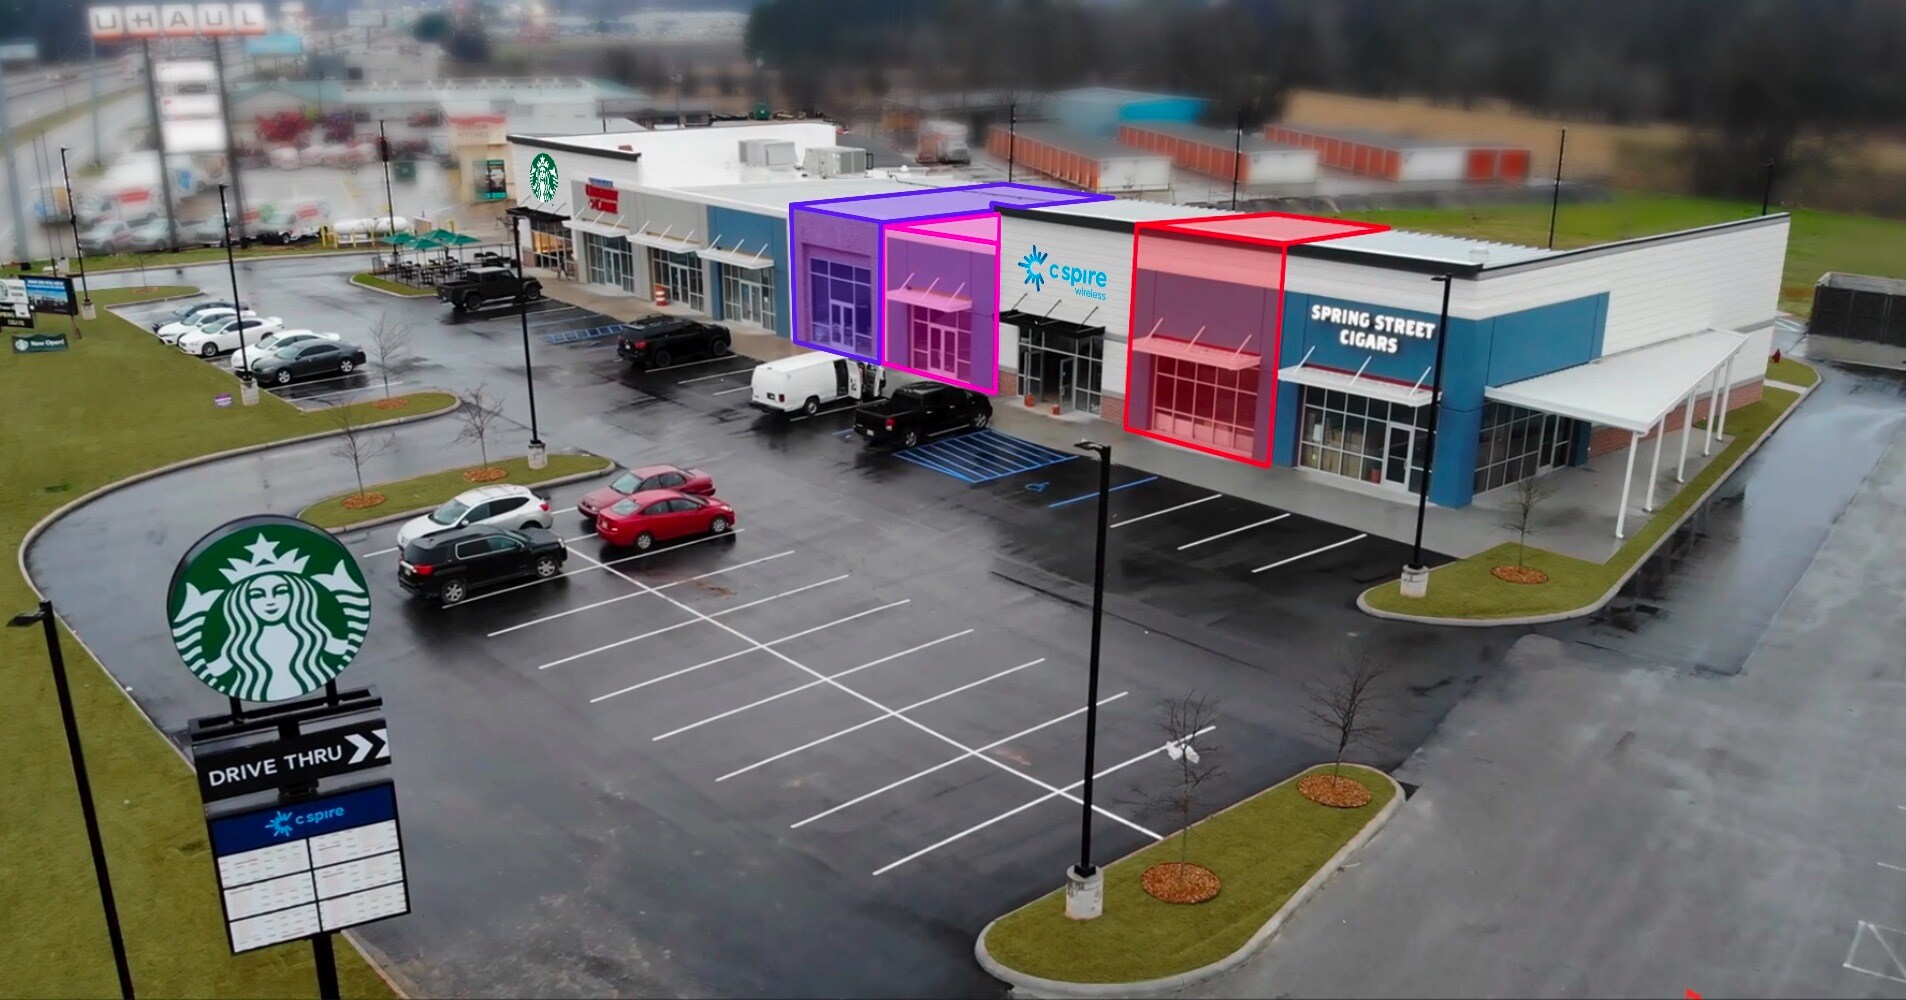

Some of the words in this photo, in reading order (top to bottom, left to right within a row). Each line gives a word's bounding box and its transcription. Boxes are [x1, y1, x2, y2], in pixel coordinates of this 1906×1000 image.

[1074, 287, 1107, 301] wireless
[1311, 304, 1370, 328] SPRING
[1373, 314, 1436, 339] STREET
[1339, 329, 1398, 354] CIGARS
[208, 758, 278, 787] DRIVE
[283, 744, 342, 770] THRU
